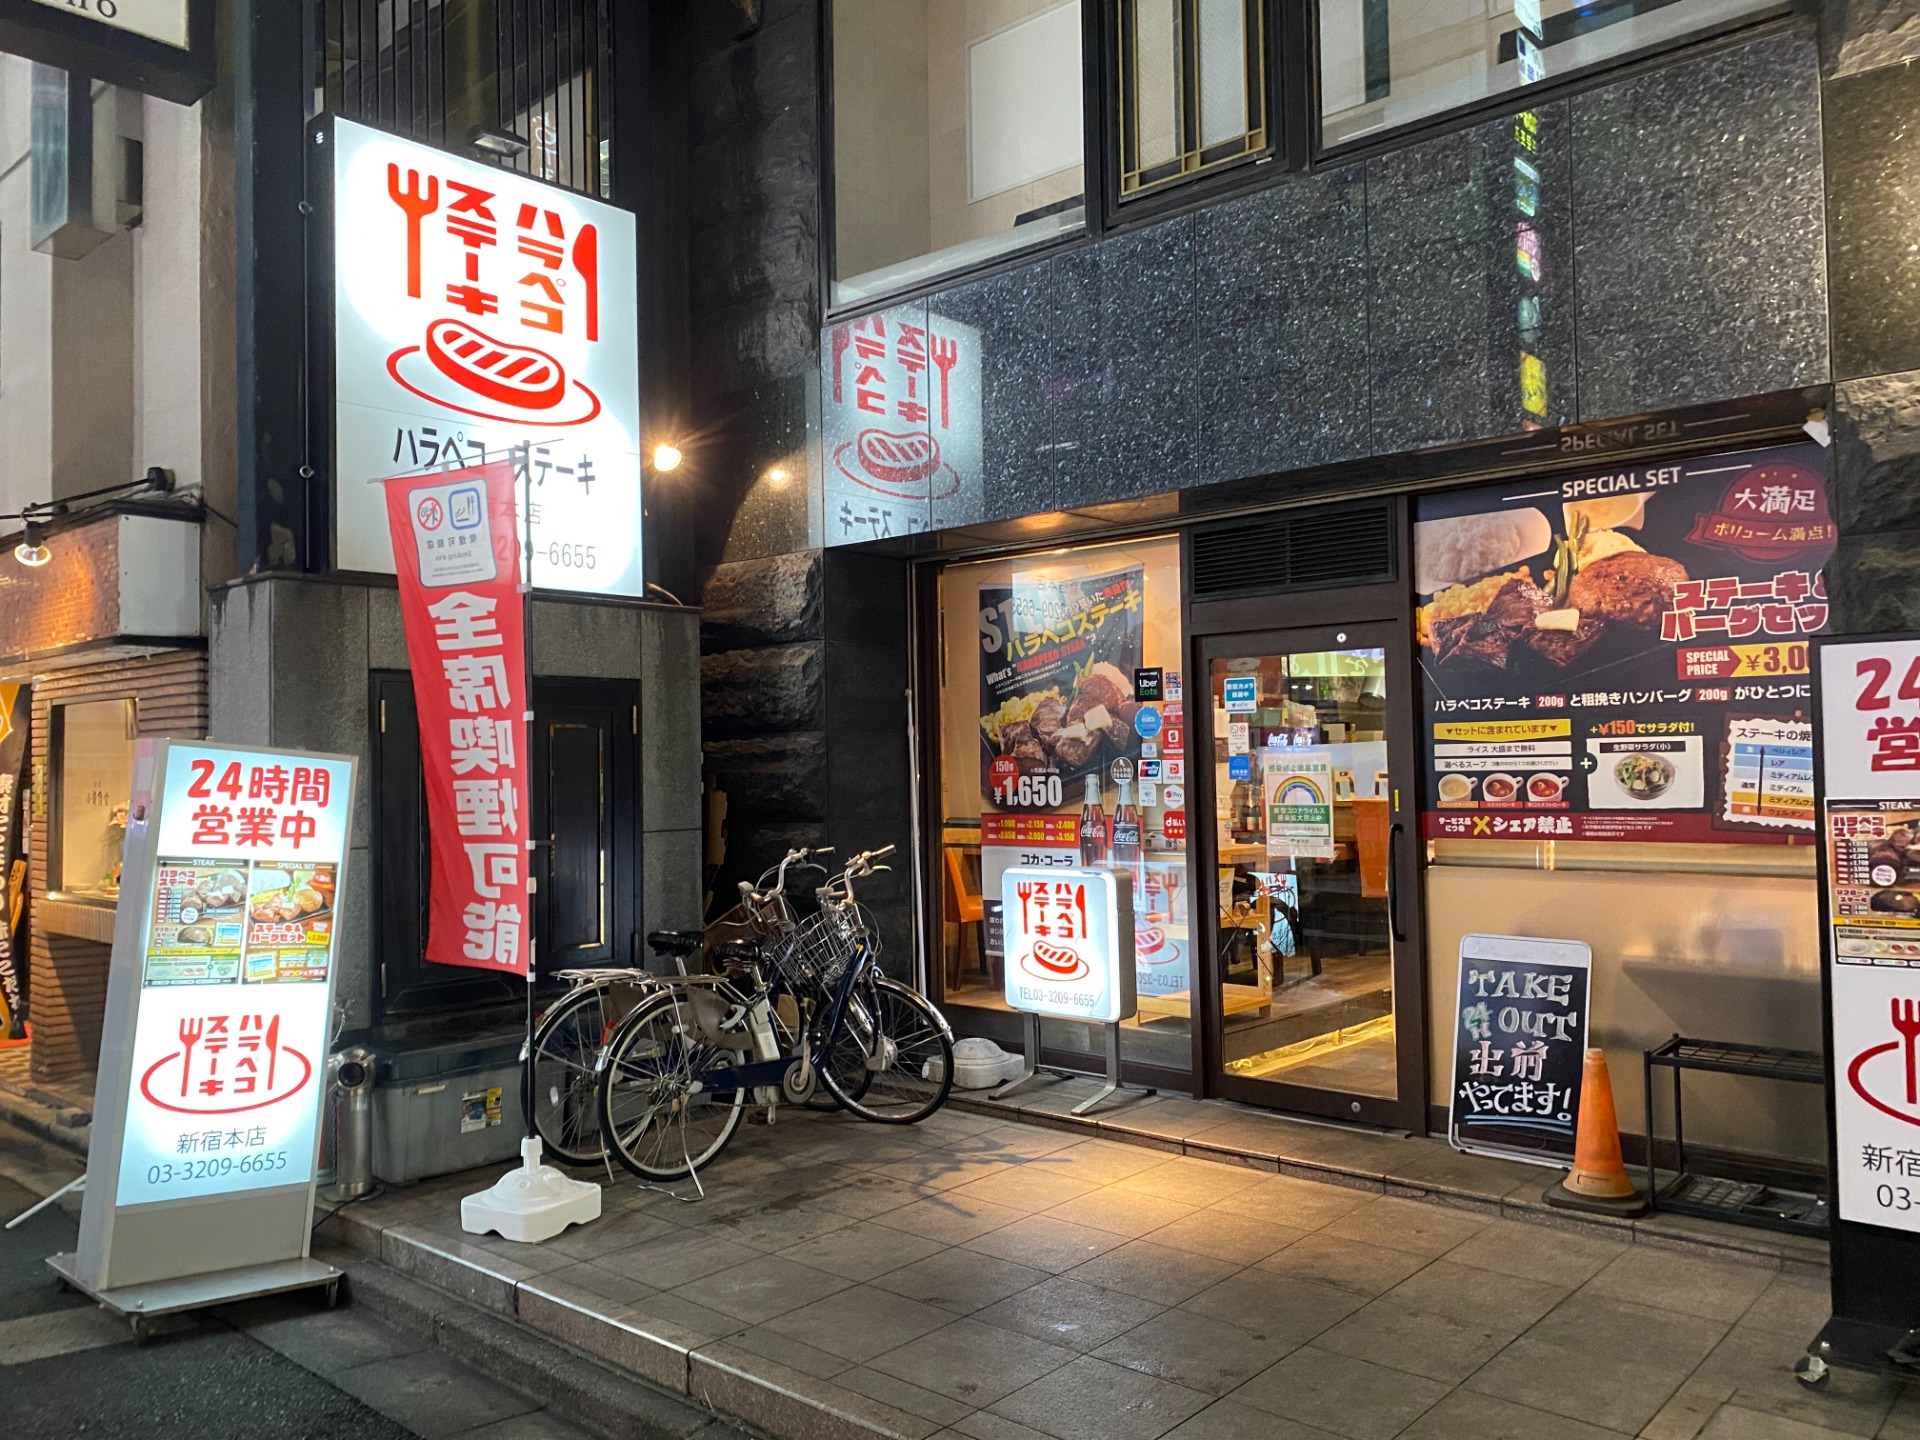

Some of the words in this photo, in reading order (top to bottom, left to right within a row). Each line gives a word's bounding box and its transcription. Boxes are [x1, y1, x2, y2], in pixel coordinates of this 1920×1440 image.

[446, 179, 498, 316] ステーキ
[515, 203, 567, 334] ハラペコ
[1562, 472, 1641, 498] SPECIAL
[1645, 466, 1682, 487] SET
[1734, 485, 1815, 514] 大満足
[1006, 589, 1142, 662] ハラペコステーキ
[1686, 650, 1730, 664] SPECIAL
[1687, 664, 1719, 676] PRICE
[1745, 646, 1809, 674] ¥3,0
[1139, 680, 1158, 688] Uber
[1434, 696, 1530, 712] ハラペコステーキ
[1538, 696, 1564, 708] 200g
[1569, 688, 1691, 707] と粗挽きハンバーグ
[1699, 688, 1728, 702] 200g
[1735, 685, 1811, 700] がひとつに
[1467, 745, 1489, 753] ライス
[995, 760, 1014, 772] 150g
[187, 759, 330, 809] 24時間
[994, 775, 1063, 807] ¥1,650
[1878, 801, 1912, 810] STEAK
[191, 804, 316, 849] 営業中
[1021, 854, 1073, 866] コカ・コーラ
[1034, 882, 1051, 936] ステーキ
[1055, 883, 1074, 939] ハラペコ
[1468, 970, 1573, 1007] TAKE
[1498, 1006, 1577, 1042] OUT
[199, 1015, 230, 1096] ステーキ
[234, 1014, 263, 1093] ハラペコ
[1469, 1040, 1549, 1082] 出前
[1459, 1081, 1572, 1121] やってます!
[176, 1125, 267, 1155] 新宿本店
[147, 1151, 287, 1184] 03-3209-6655
